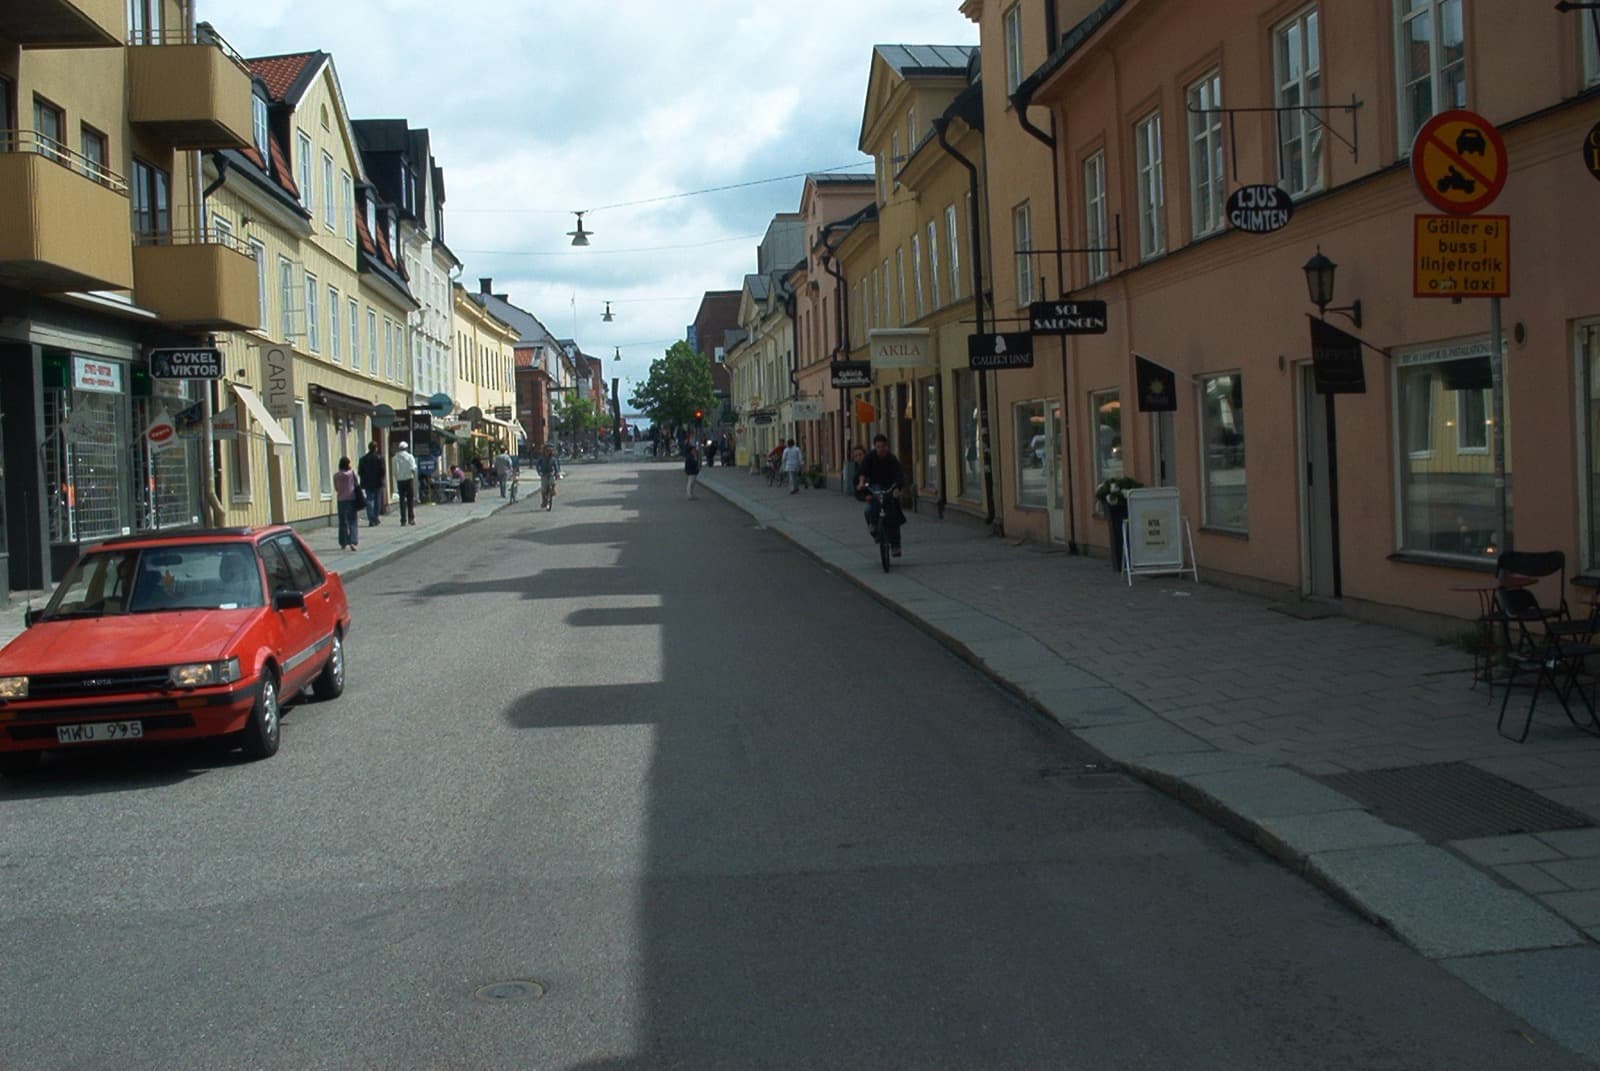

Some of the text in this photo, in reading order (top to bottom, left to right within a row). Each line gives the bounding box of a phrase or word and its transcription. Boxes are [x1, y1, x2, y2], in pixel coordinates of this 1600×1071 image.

[1237, 186, 1278, 208] LJUS
[1231, 208, 1288, 231] GLIMTEN
[1427, 219, 1499, 238] Gäller ej
[1439, 239, 1488, 254] buss i
[1421, 256, 1503, 273] linjetrafik
[1463, 276, 1496, 290] taxi
[1055, 304, 1080, 315] SOL
[1033, 317, 1104, 329] SALONGEN
[173, 352, 216, 363] CYKEL
[879, 344, 921, 357] AKILA
[170, 365, 218, 376] VIKTOR
[106, 722, 141, 738] 995
